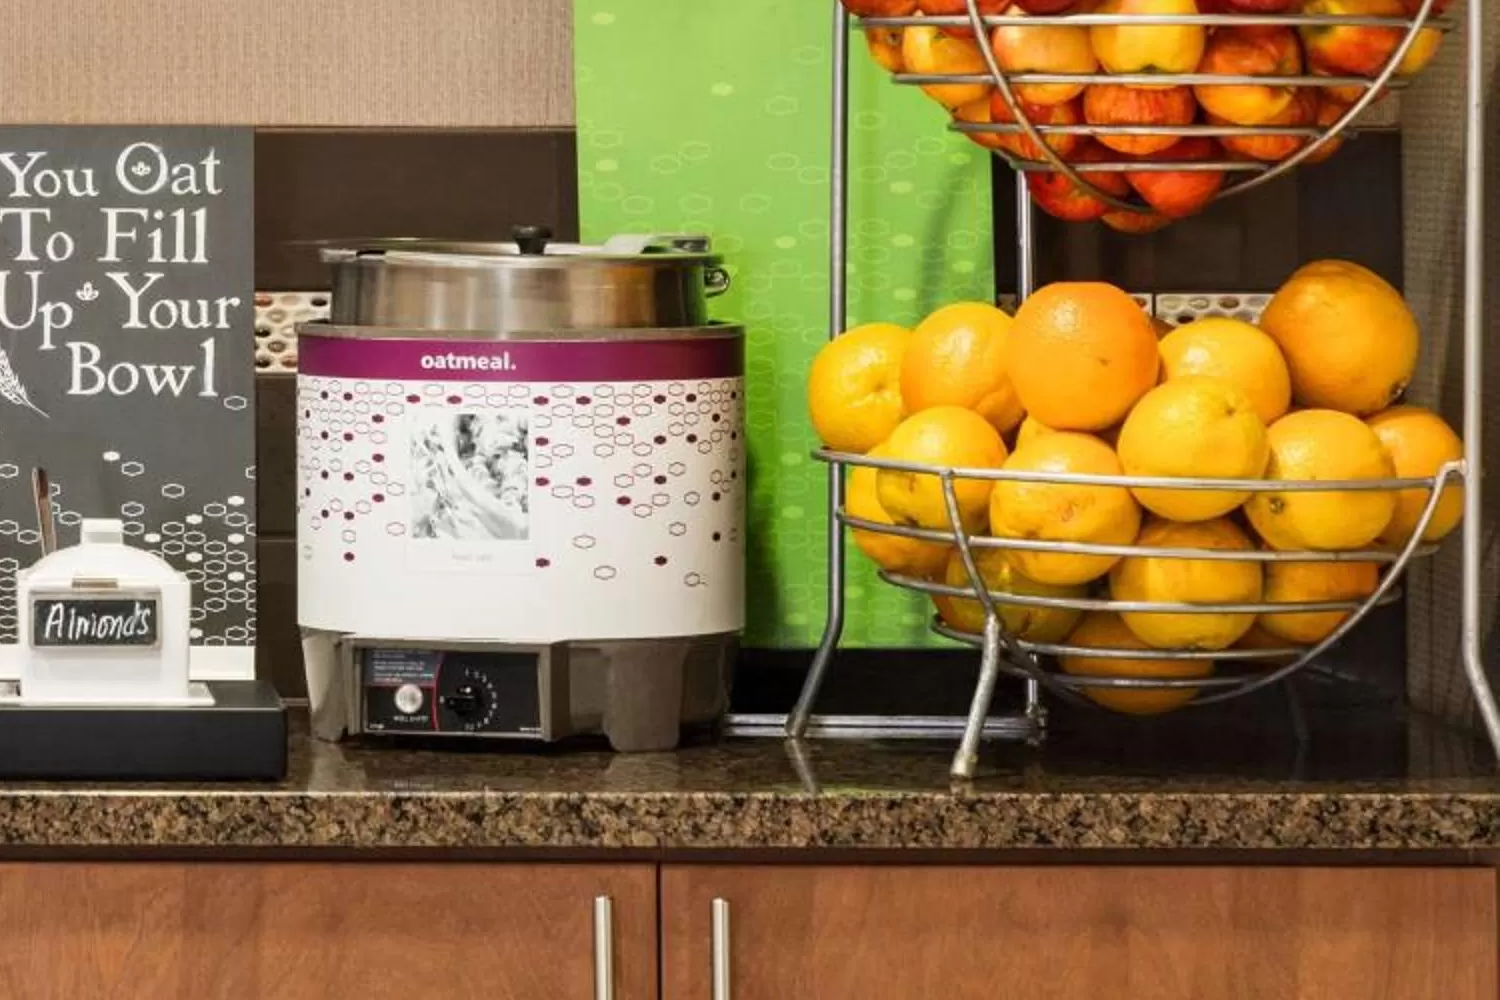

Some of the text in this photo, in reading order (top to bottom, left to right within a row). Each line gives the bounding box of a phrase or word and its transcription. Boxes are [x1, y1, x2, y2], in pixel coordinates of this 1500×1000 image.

[115, 141, 223, 195] Oat
[0, 207, 209, 263] To Fill
[105, 271, 241, 329] Your
[65, 336, 219, 397] Bowl
[420, 350, 517, 370] oatmeal.
[44, 602, 152, 640] Almonds
